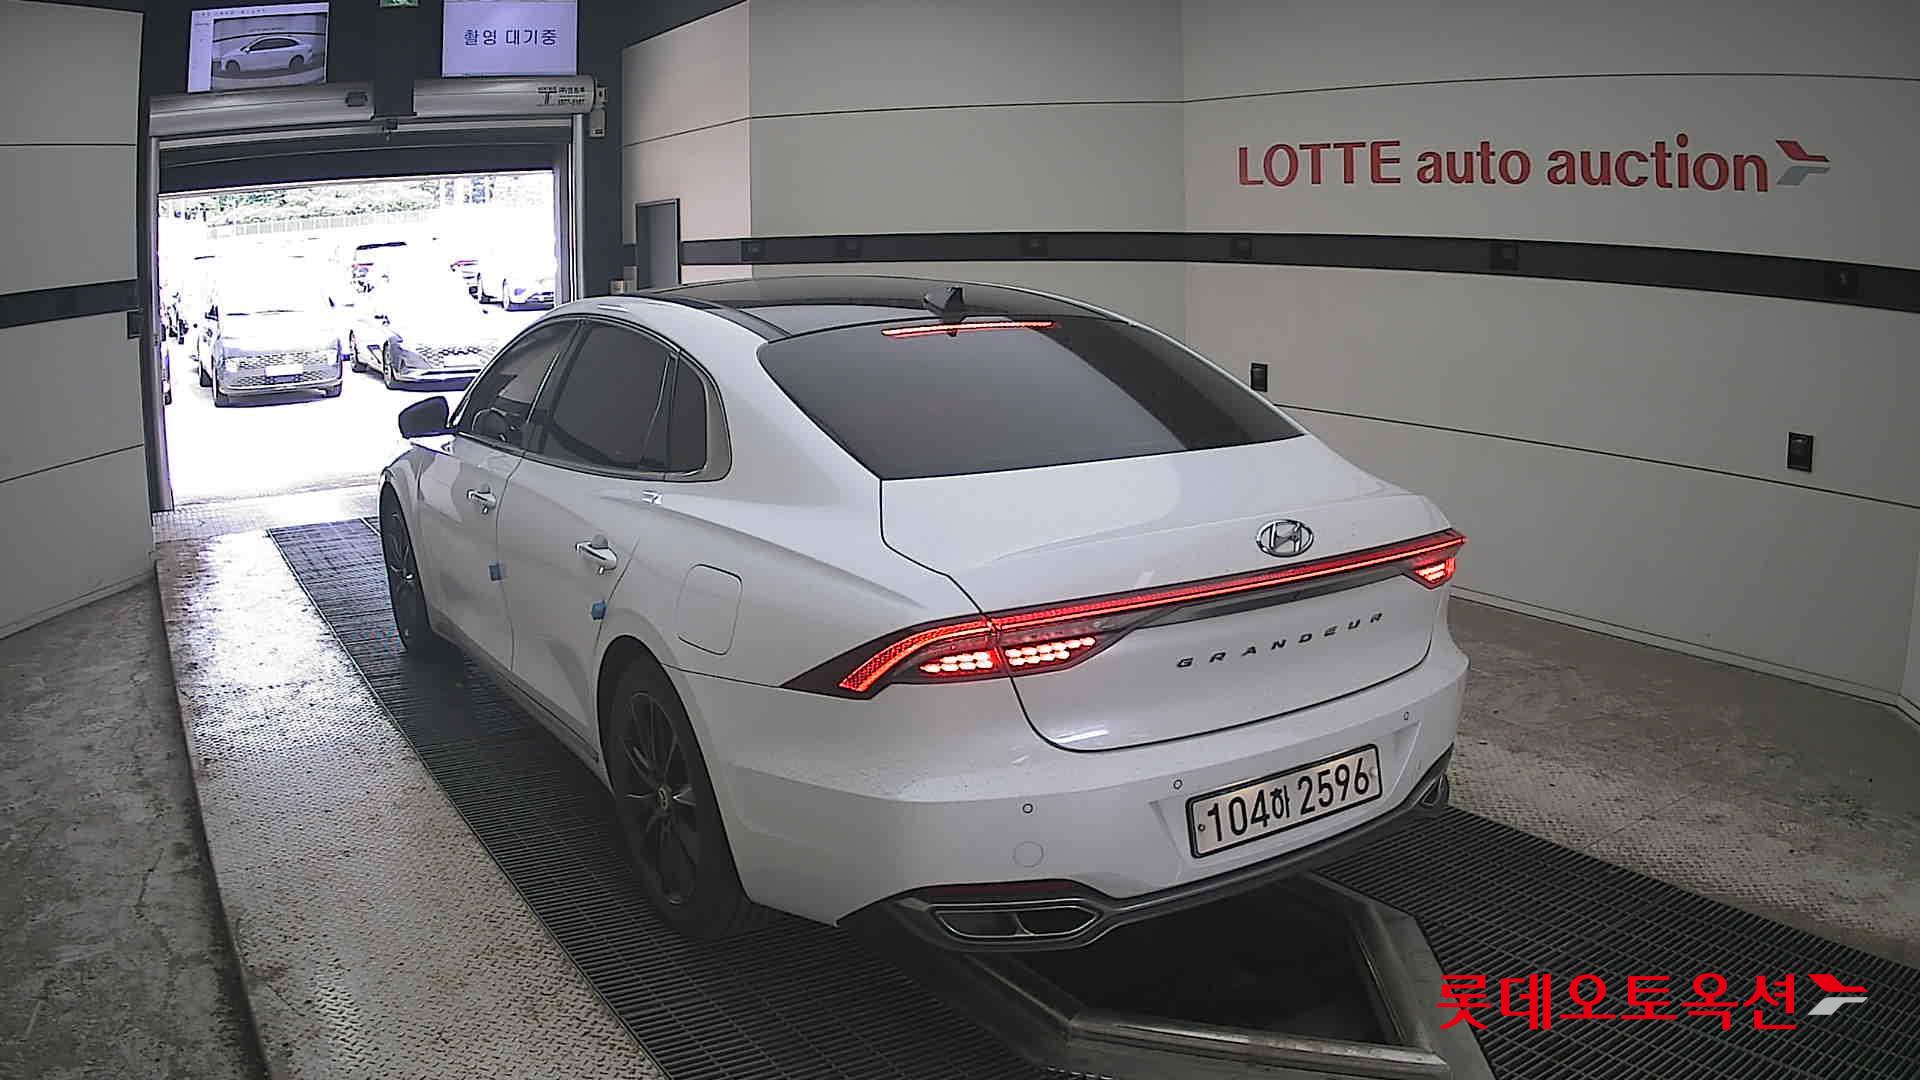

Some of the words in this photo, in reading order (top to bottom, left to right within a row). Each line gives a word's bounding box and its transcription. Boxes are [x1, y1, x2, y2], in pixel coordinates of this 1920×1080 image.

[464, 29, 497, 46] 촬영
[505, 29, 558, 46] 대기중
[1238, 140, 1401, 187] LOTTE
[1416, 141, 1532, 185] auto
[1546, 133, 1769, 193] auction
[1176, 612, 1383, 668] GRANDEUR
[1207, 785, 1291, 842] 104하
[1297, 757, 1370, 815] 2596
